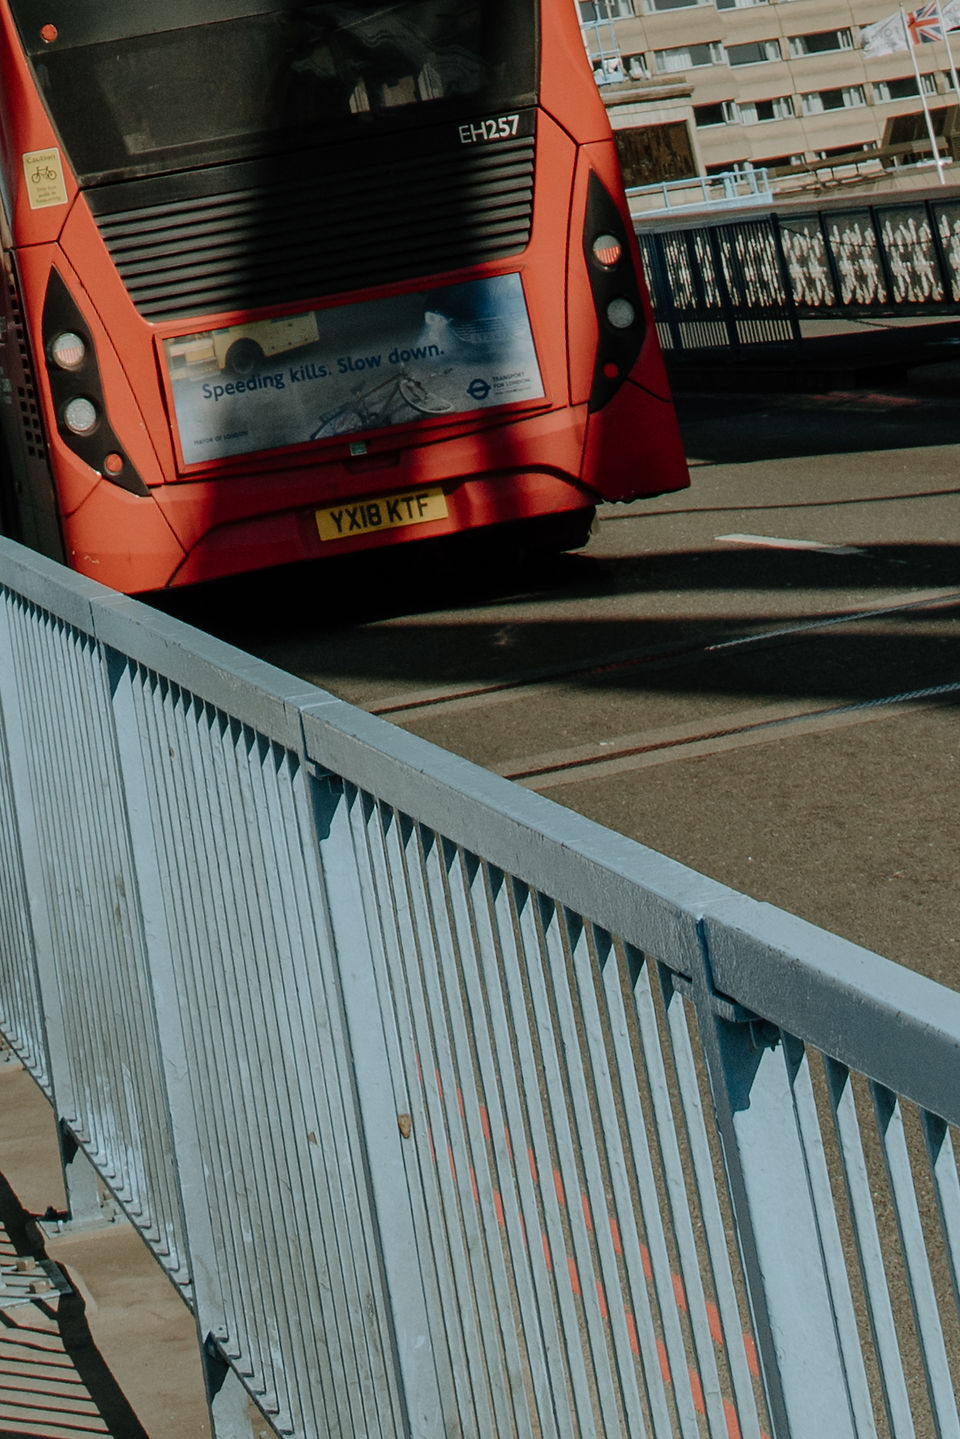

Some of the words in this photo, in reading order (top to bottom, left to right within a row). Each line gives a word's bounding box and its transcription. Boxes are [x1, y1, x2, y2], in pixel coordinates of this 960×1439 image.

[458, 114, 520, 144] EH257
[202, 371, 285, 401] Speeding
[289, 362, 332, 383] kills.
[337, 355, 381, 374] Slow
[388, 343, 445, 365] down.
[329, 503, 383, 533] YX18
[385, 493, 429, 523] KTF
